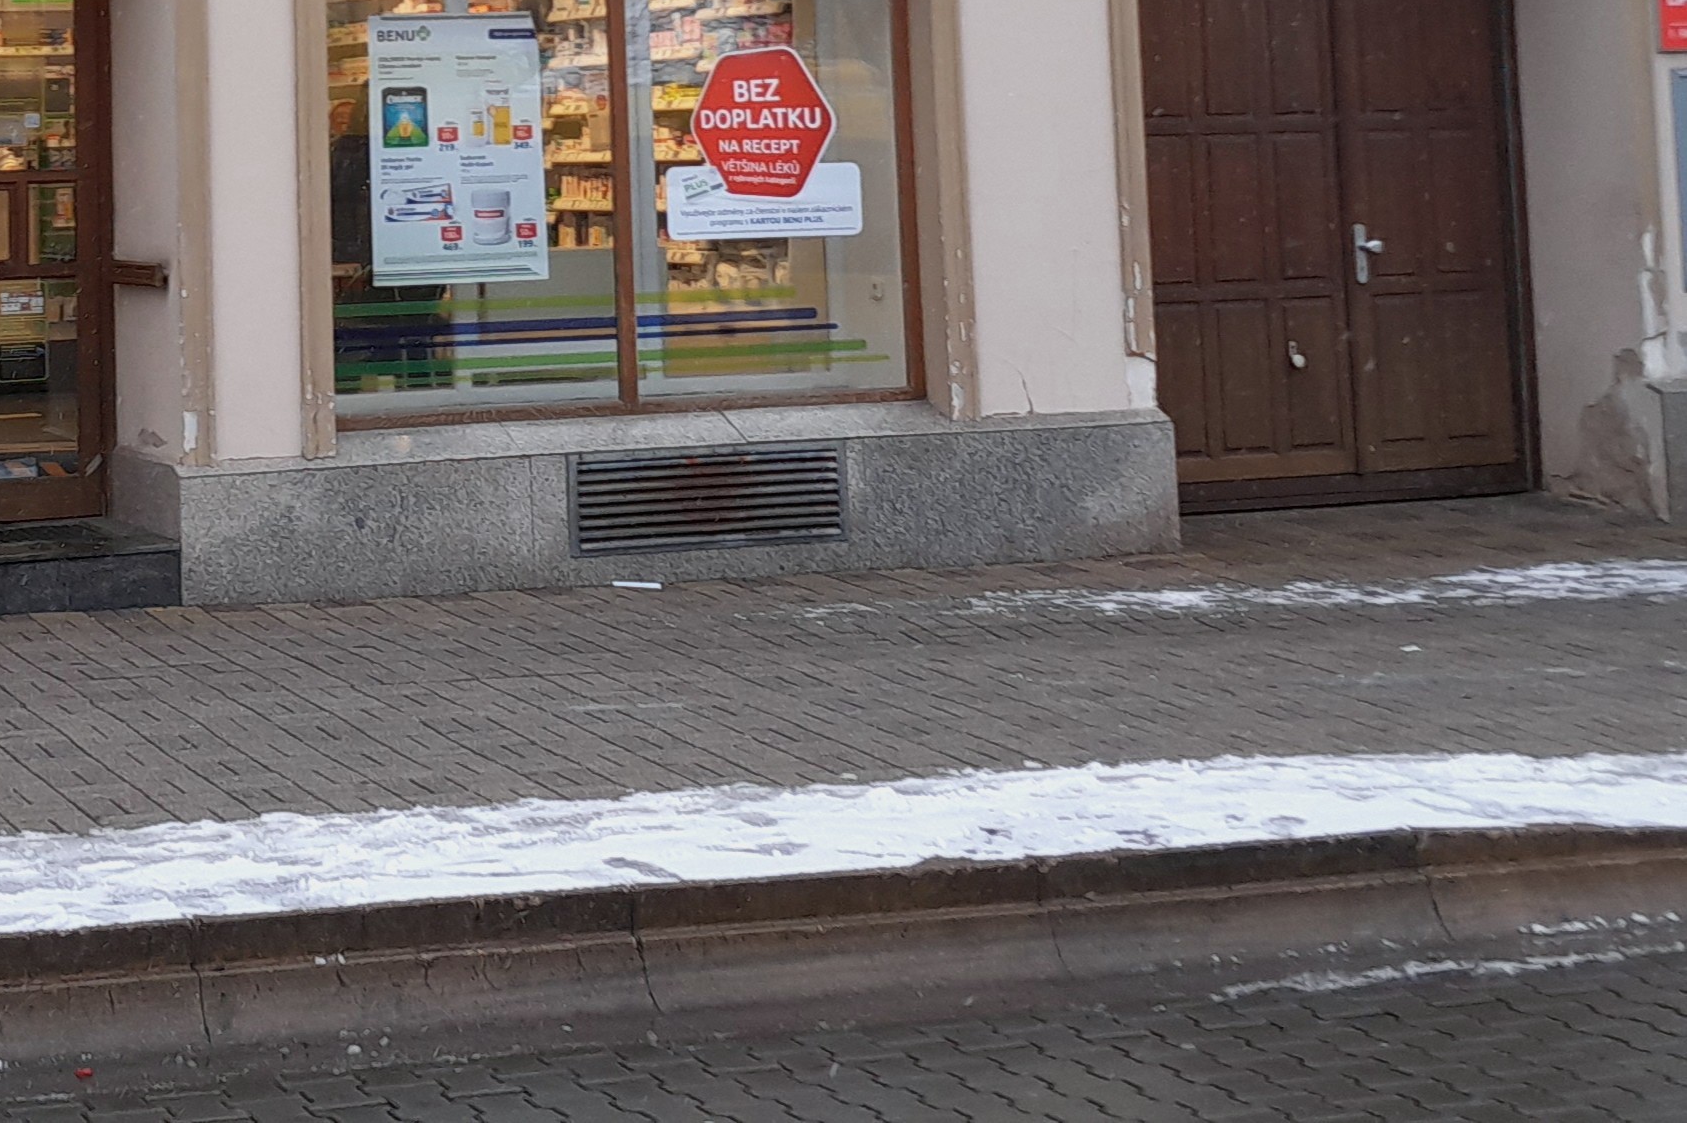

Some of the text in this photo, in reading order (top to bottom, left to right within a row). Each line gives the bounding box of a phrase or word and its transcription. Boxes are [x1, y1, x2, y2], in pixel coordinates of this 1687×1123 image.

[376, 30, 415, 43] BENU
[732, 78, 781, 103] BEZ
[700, 107, 823, 130] DOPLATKU
[718, 139, 801, 155] NA RECEPT
[721, 158, 801, 175] VĚTŠINA LÉKŮ
[683, 179, 709, 193] PLUS
